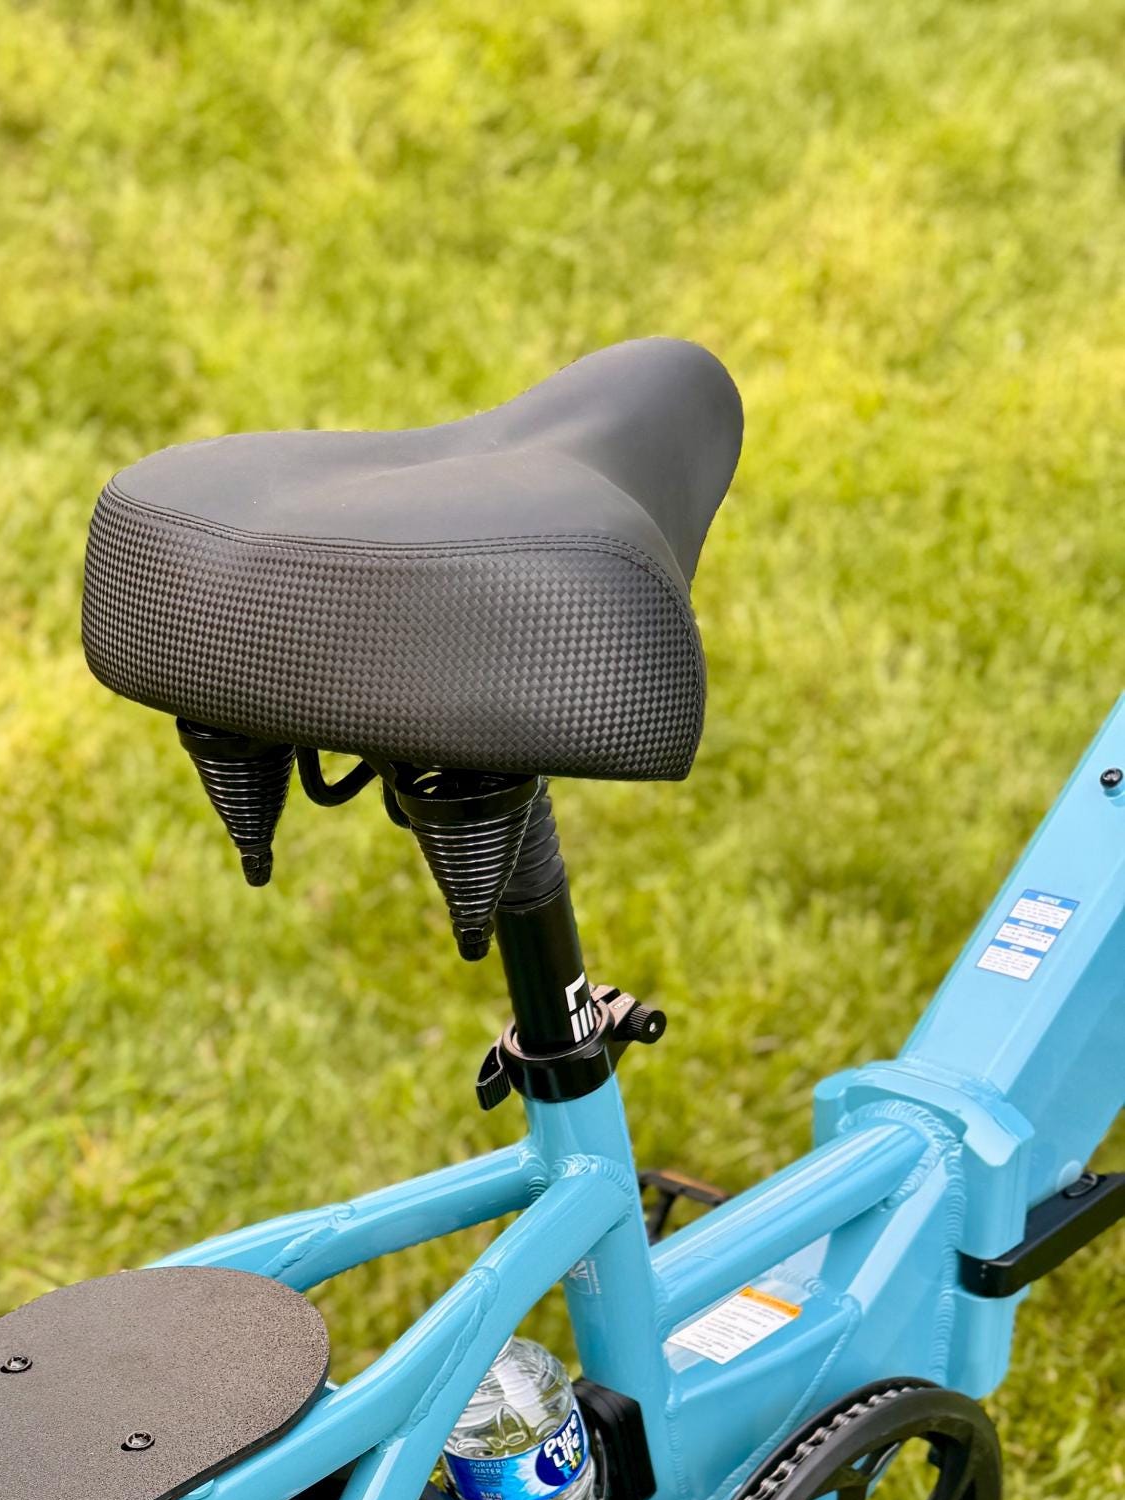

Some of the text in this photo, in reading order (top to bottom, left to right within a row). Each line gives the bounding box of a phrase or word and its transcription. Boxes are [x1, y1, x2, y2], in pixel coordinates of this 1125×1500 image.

[543, 1413, 578, 1458] Pure
[552, 1432, 580, 1468] Life
[469, 1459, 508, 1468] PURIFIED
